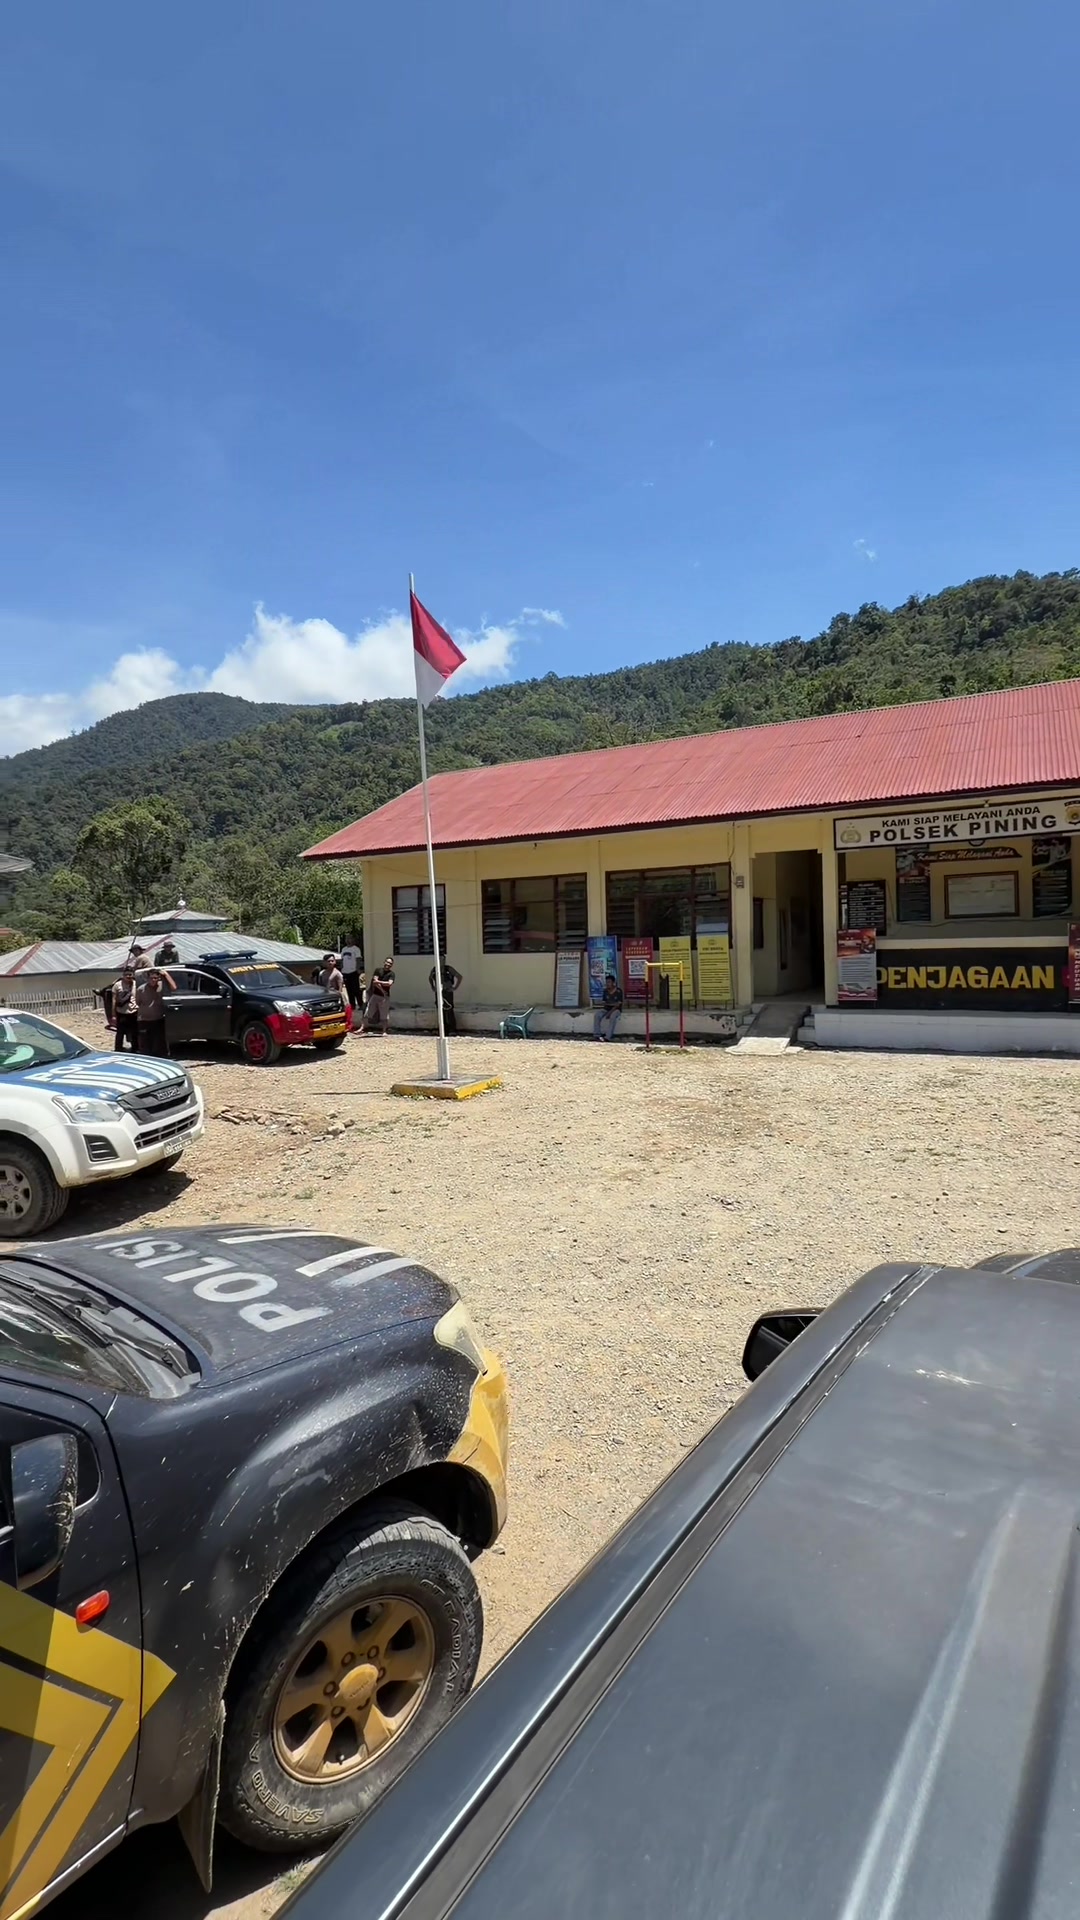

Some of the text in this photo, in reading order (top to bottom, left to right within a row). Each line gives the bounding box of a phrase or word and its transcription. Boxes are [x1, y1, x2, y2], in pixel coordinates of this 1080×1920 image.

[869, 815, 1057, 843] POLSEK PINING
[882, 806, 1041, 828] KAMI SIAP MELAYANI ANDA
[94, 1236, 334, 1333] POLISI
[251, 1768, 325, 1824] SAVERO
